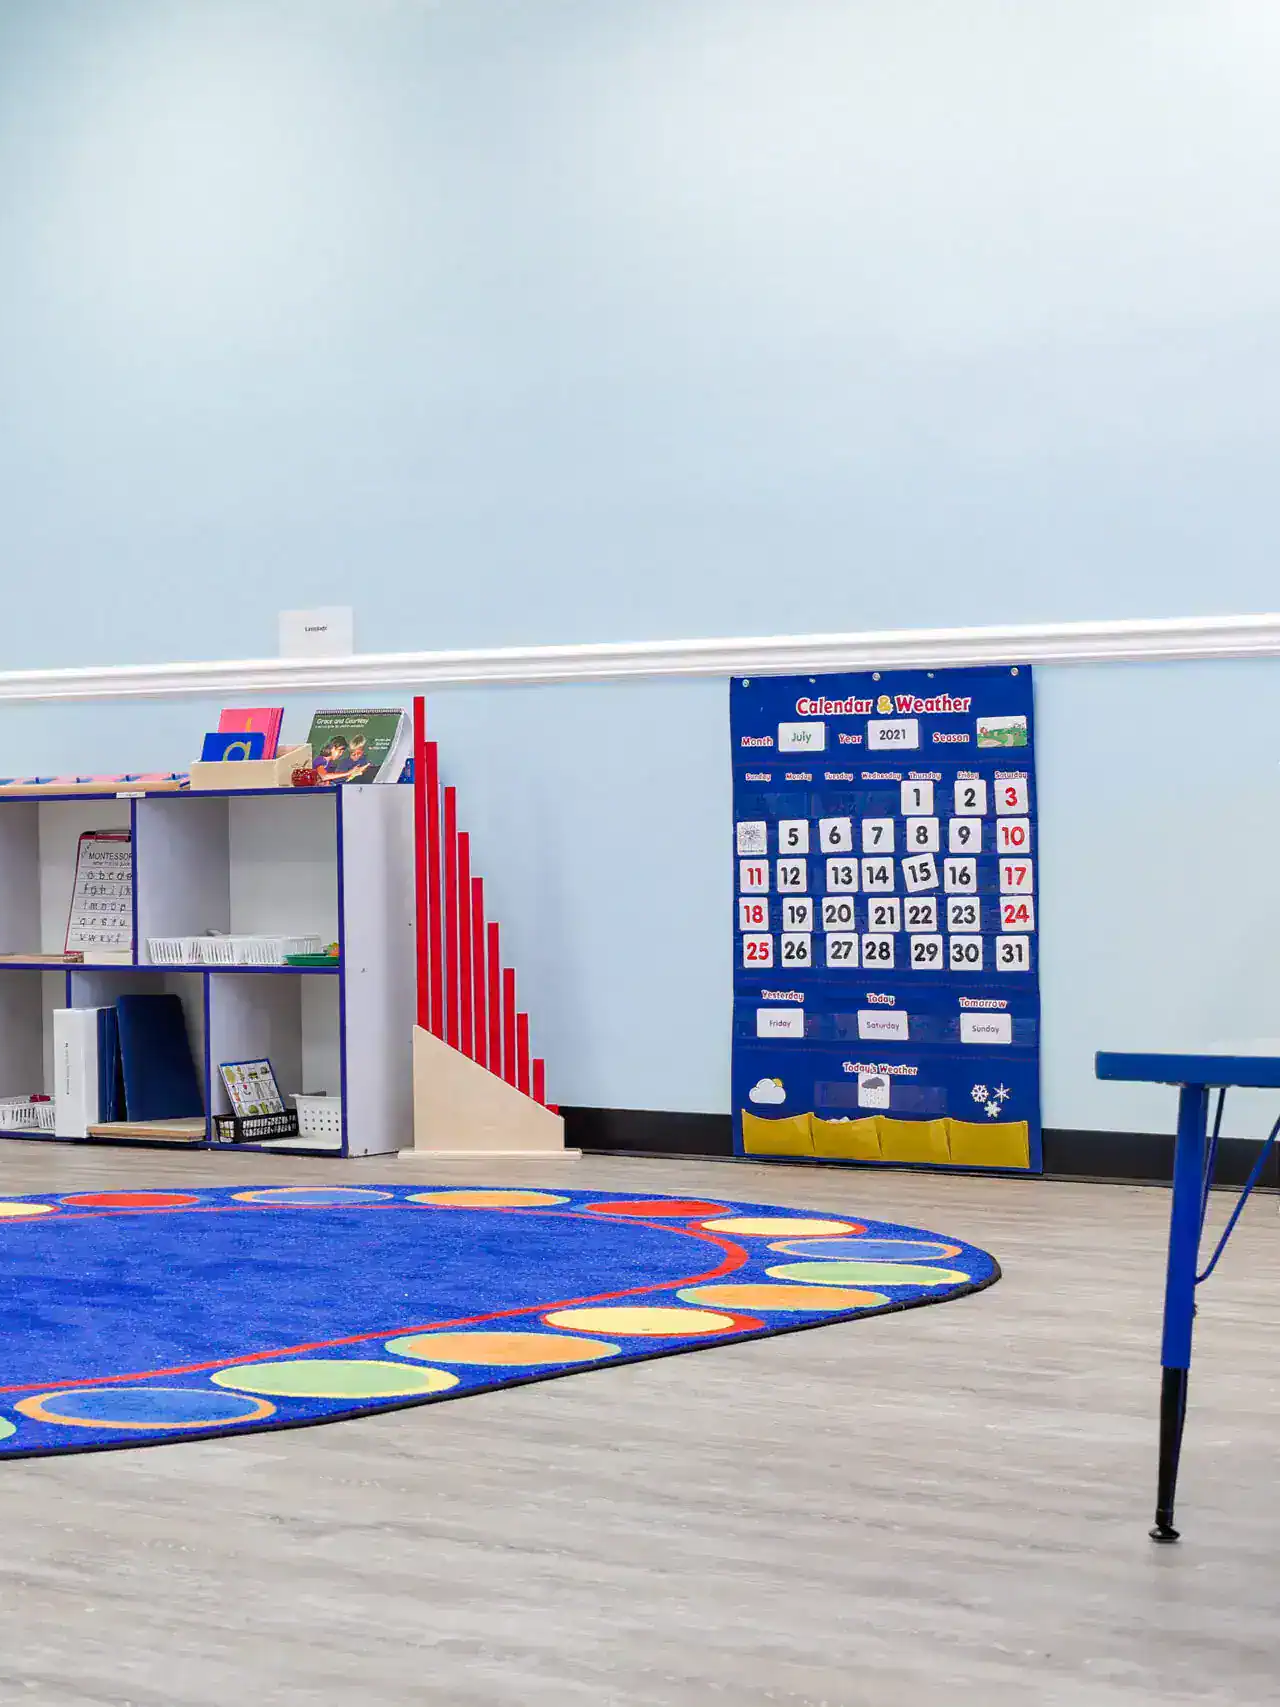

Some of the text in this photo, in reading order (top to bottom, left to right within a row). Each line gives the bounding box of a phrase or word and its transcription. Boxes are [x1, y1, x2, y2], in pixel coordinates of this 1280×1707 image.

[797, 695, 970, 714] Calendar & Weather
[742, 736, 773, 747] Month
[791, 731, 812, 744] July
[839, 733, 862, 744] Year
[879, 729, 907, 741] 2021
[933, 732, 970, 743] Season
[223, 741, 251, 761] a
[745, 771, 1028, 782] Sunday Monday Tuesday Wednesday Thursday Friday Saturday
[914, 787, 1017, 807] 1 2 3
[788, 826, 1024, 846] 5 6 7 8 9 10
[748, 862, 1026, 885] 11 12 13 14 15 16 17
[744, 904, 1029, 924] 18 19 20 21 22 23 24
[747, 941, 1022, 962] 25 26 27 28 29 30 31
[761, 990, 1007, 1009] Yesterday Today Tomorrow
[769, 1019, 792, 1029] Friday
[866, 1021, 900, 1032] Saturday
[972, 1025, 1000, 1035] Sunday
[843, 1062, 918, 1076] Today's Weather
